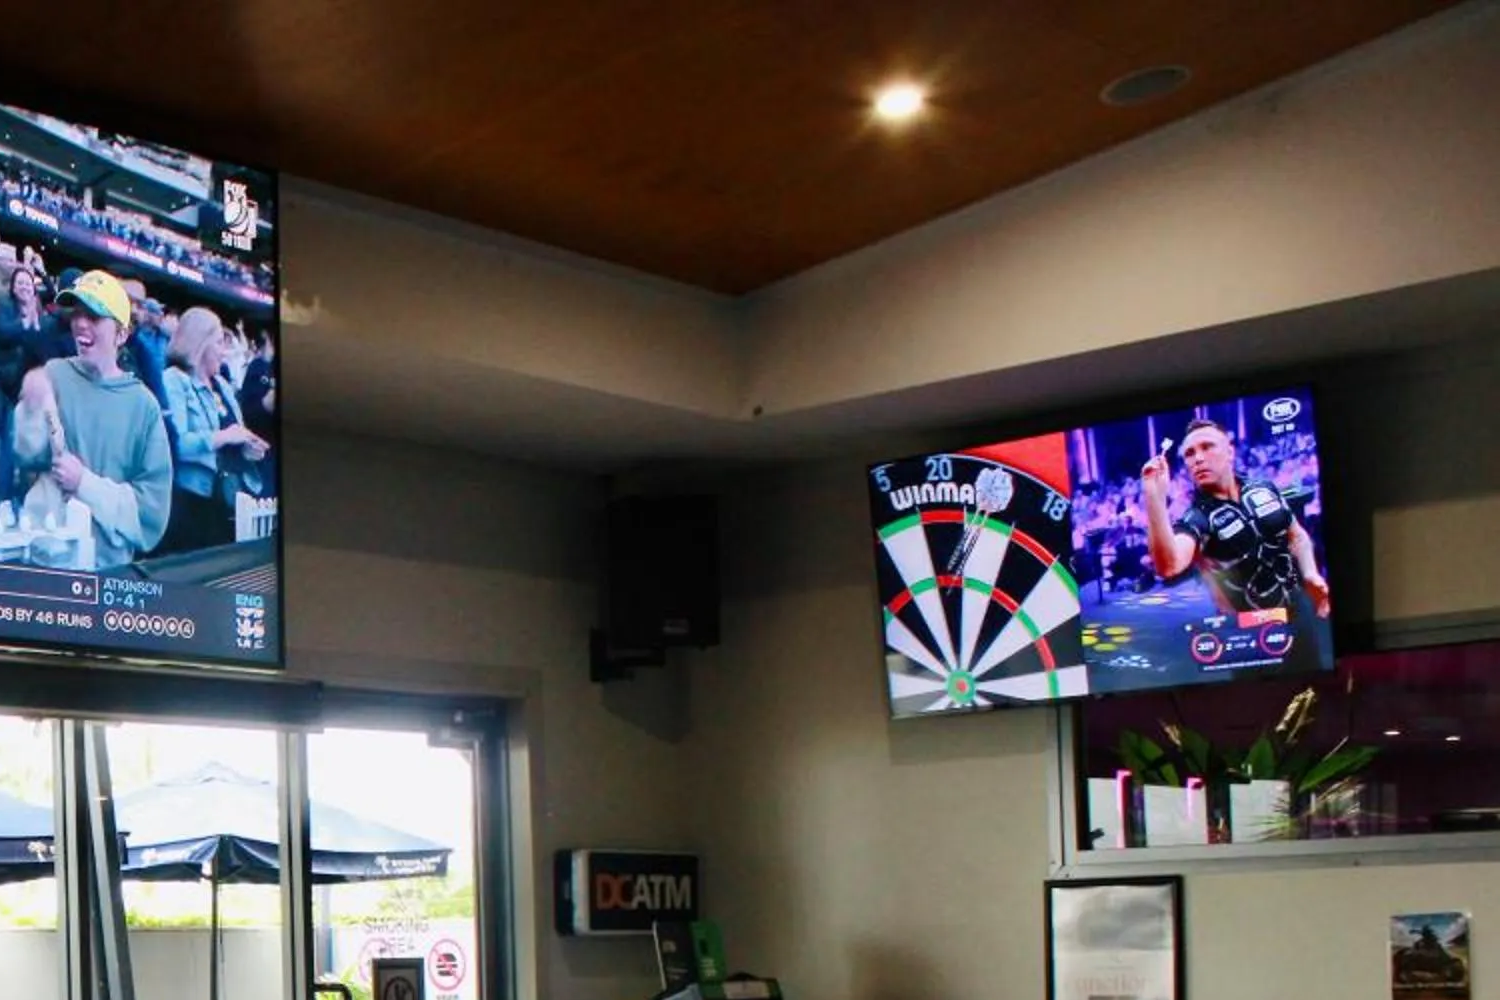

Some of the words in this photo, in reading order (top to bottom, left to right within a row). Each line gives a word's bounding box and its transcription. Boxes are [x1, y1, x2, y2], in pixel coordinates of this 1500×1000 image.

[925, 457, 953, 482] 20
[874, 470, 892, 493] 5
[890, 480, 977, 512] WINMA
[1042, 492, 1072, 522] 18
[71, 581, 83, 595] 0
[103, 592, 136, 609] 0-4
[15, 607, 33, 622] BY
[56, 612, 93, 629] RUNS
